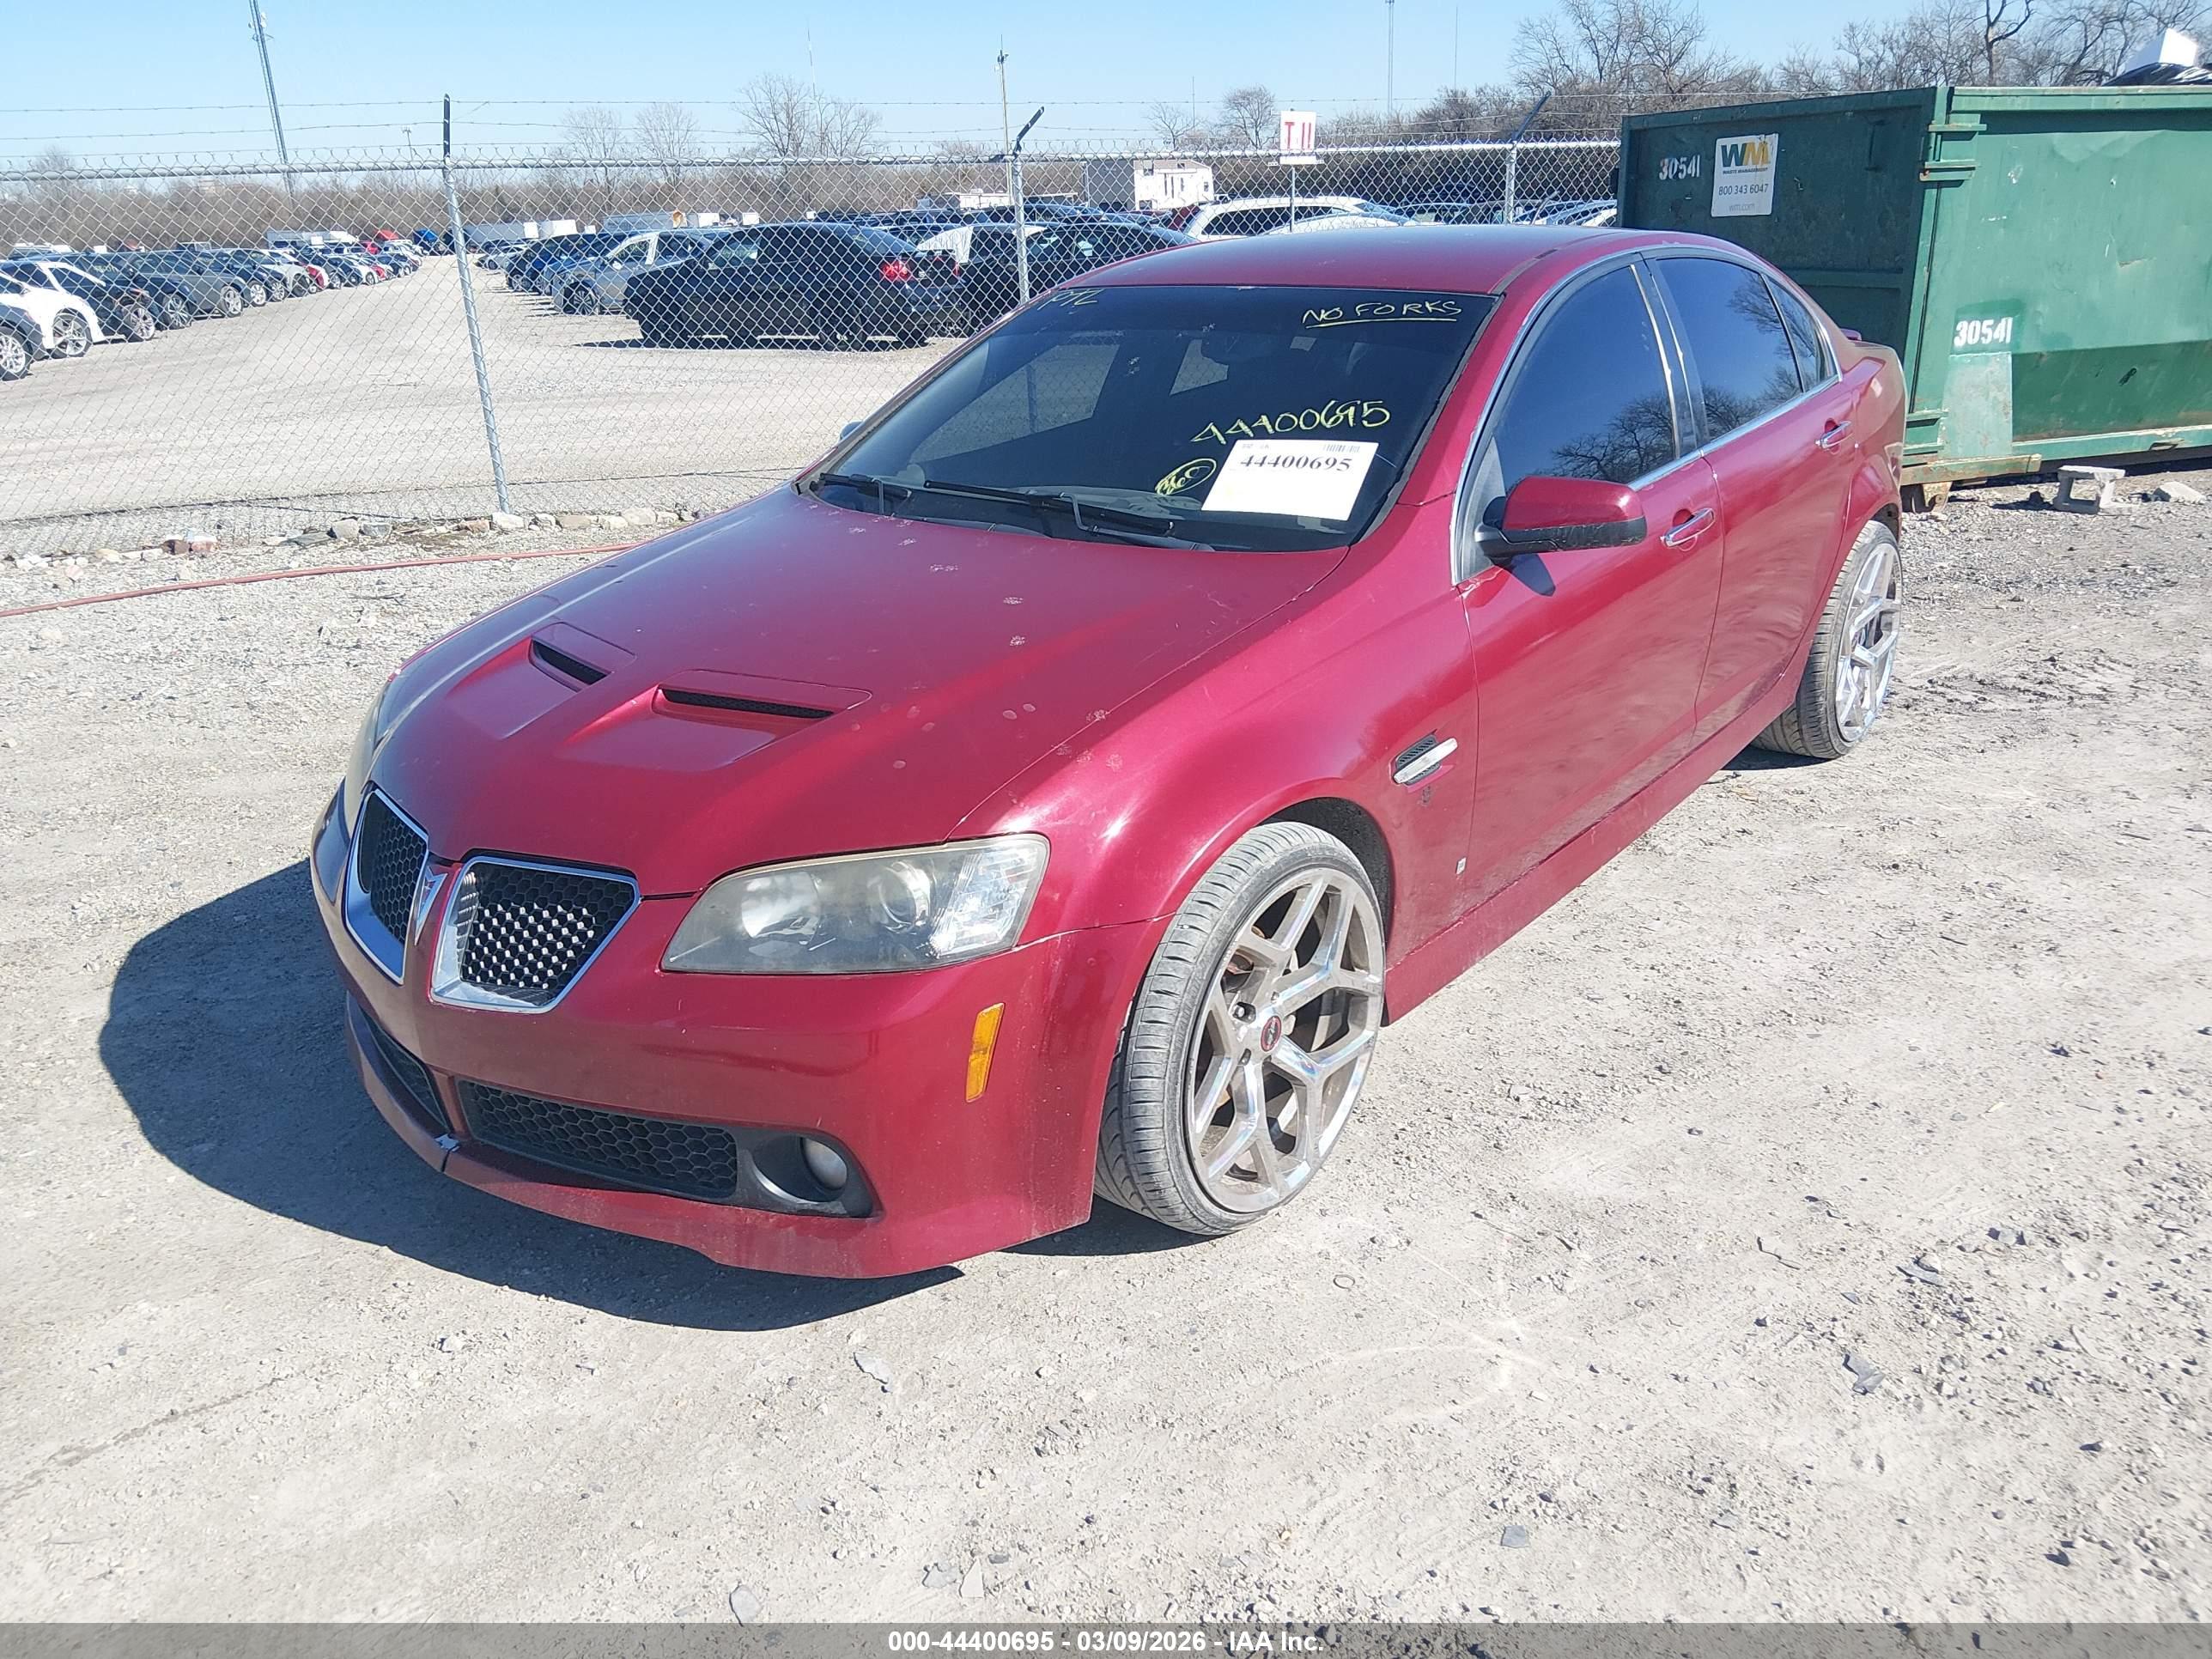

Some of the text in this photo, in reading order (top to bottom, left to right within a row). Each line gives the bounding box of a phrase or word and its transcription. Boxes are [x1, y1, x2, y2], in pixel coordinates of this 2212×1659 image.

[1721, 141, 1770, 167] WM
[1658, 155, 1700, 180] 30541
[1718, 183, 1769, 196] 800 343 6047
[1302, 301, 1462, 324] NO FORKS
[1954, 316, 2014, 347] 30541
[1190, 400, 1390, 445] 44400695
[1240, 454, 1353, 471] 44400695
